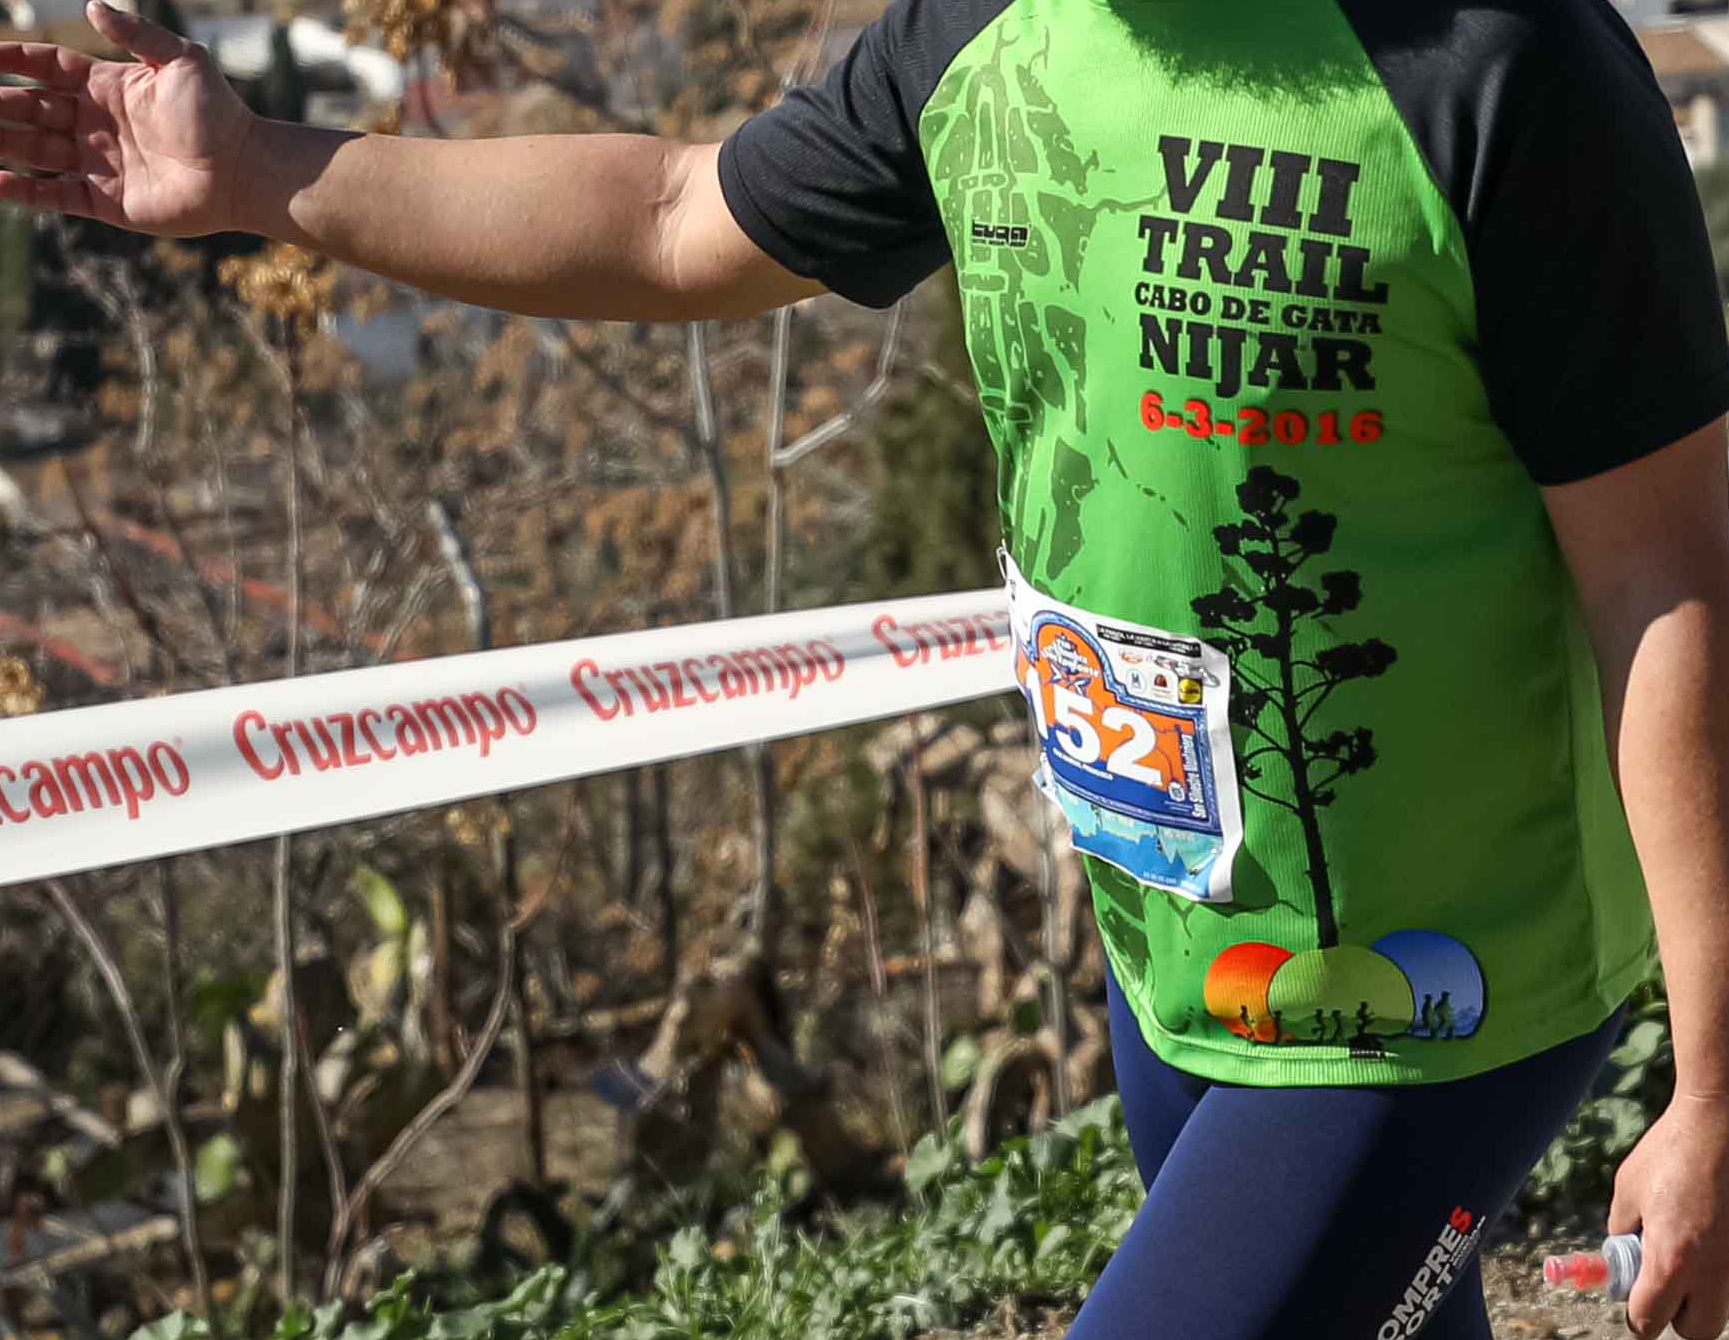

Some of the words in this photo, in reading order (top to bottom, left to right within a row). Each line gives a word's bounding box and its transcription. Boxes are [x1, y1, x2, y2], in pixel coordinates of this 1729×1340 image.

[1158, 135, 1361, 238] VIII
[1138, 214, 1390, 304] TRAIL
[1135, 281, 1212, 316] CABO
[1221, 295, 1272, 325] DE
[1281, 304, 1383, 335] GATA
[1139, 312, 1376, 398] NIJAR
[1140, 390, 1383, 446] 6-3-2016
[233, 685, 538, 783] Cruzcampo
[570, 638, 846, 723] Cruzcampo
[872, 612, 1009, 669] Cruzc
